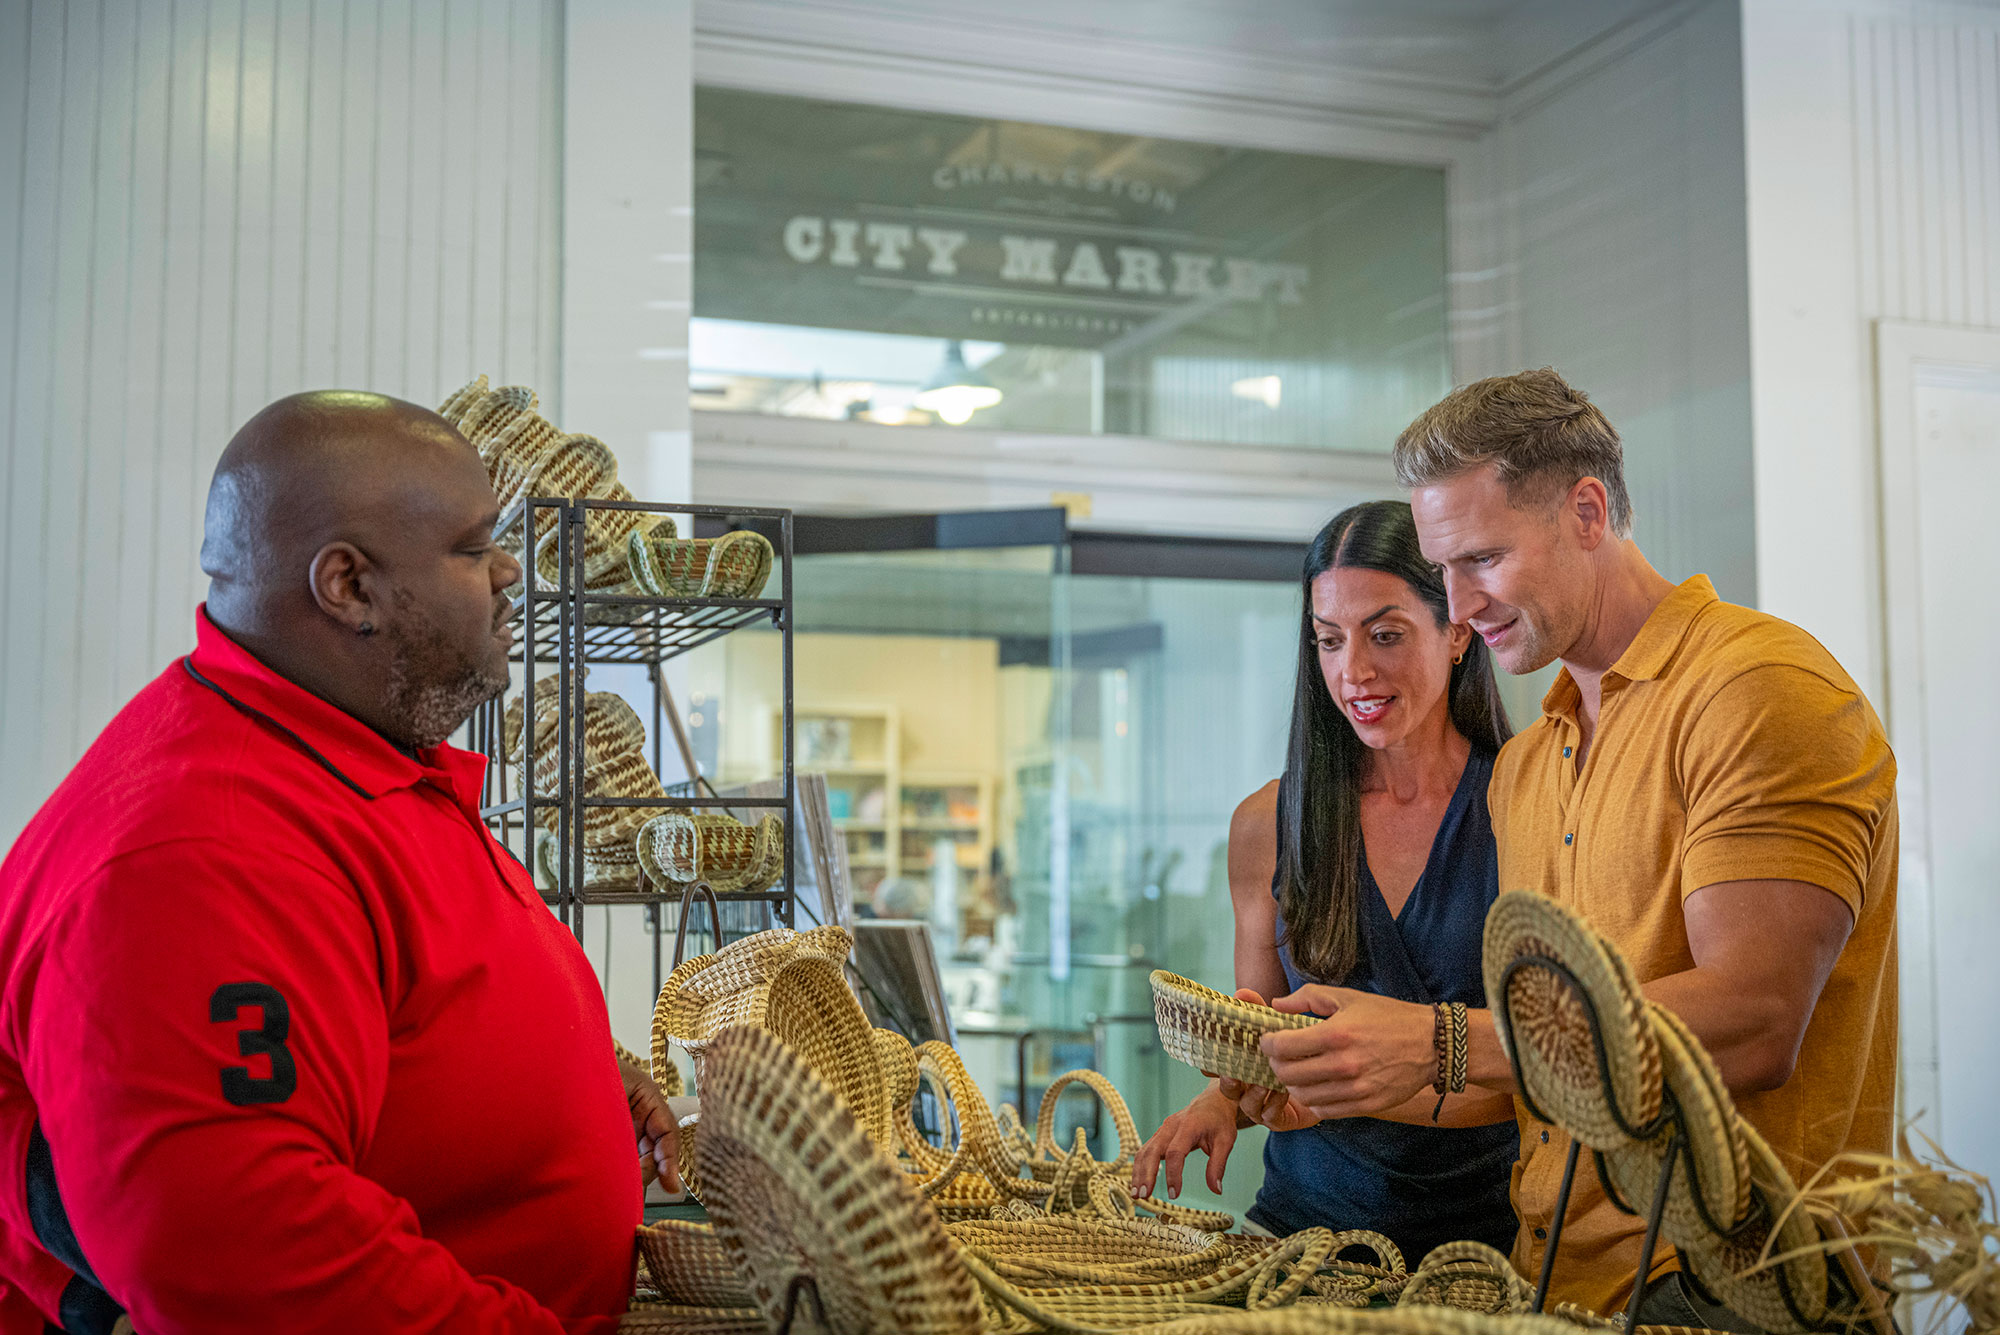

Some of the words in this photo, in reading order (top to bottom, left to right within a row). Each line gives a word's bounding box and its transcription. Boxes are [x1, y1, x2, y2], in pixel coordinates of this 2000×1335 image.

[784, 215, 967, 276] CITY
[1000, 236, 1308, 304] MARKET
[210, 982, 297, 1106] 3
